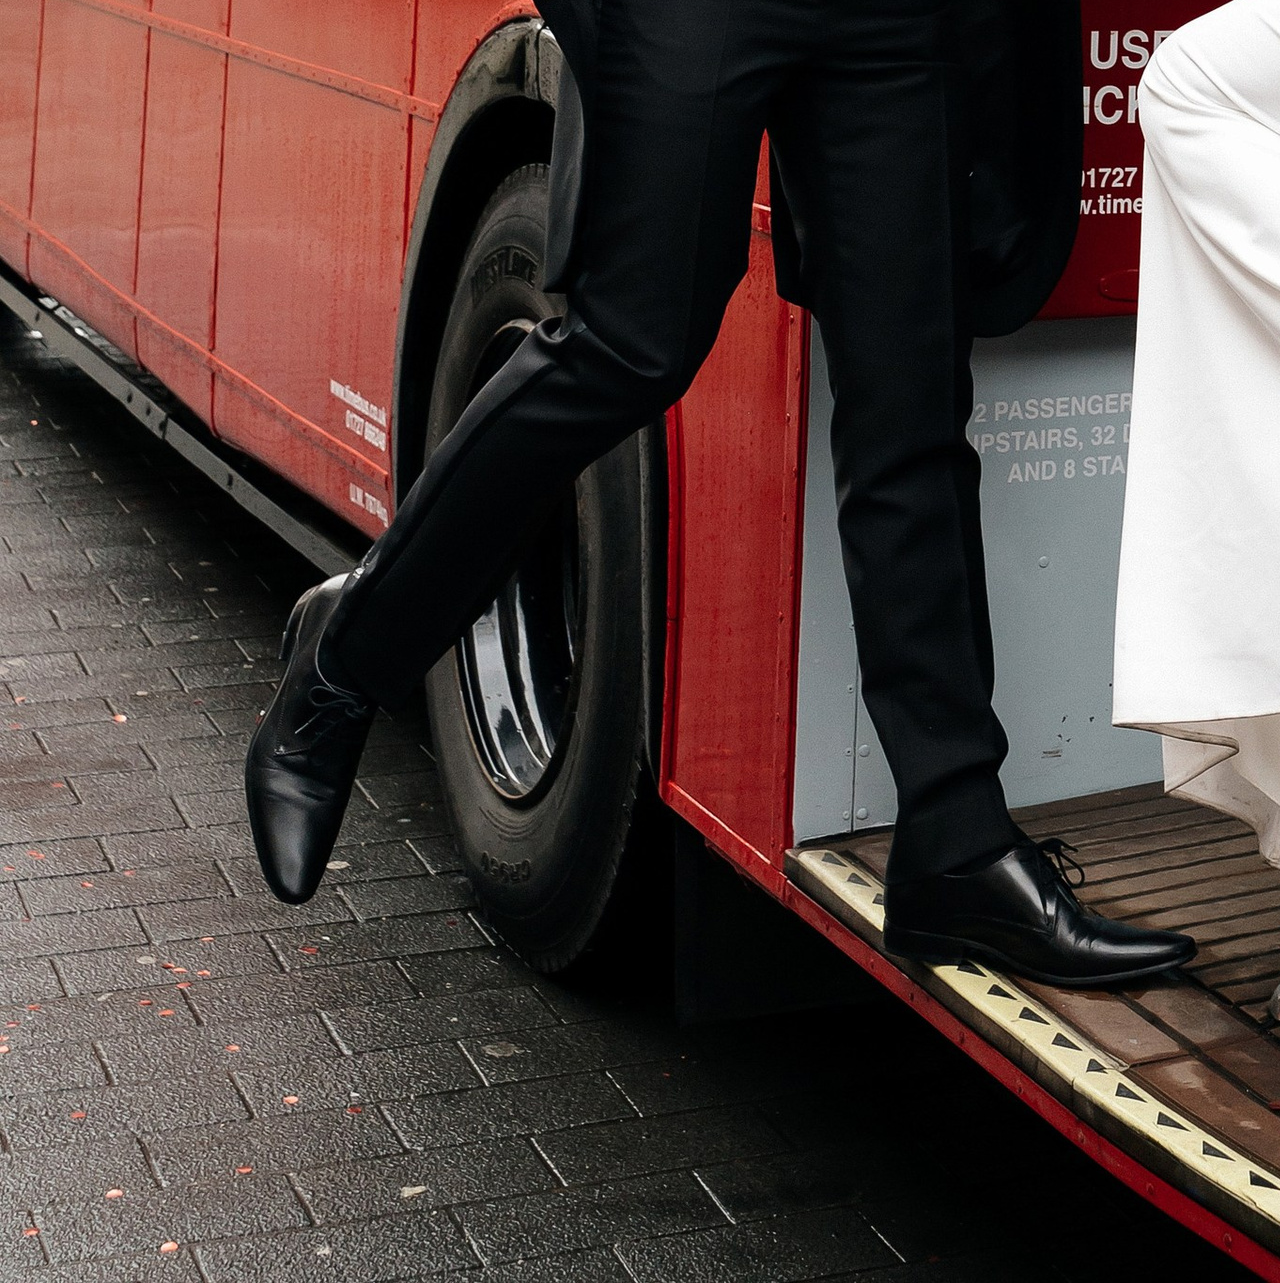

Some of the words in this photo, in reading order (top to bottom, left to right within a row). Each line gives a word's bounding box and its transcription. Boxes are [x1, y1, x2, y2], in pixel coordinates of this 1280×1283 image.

[1081, 167, 1138, 188] 1727
[1090, 424, 1116, 446] 32
[1007, 460, 1057, 483] AND
[1063, 459, 1076, 479] 8
[1083, 455, 1126, 477] STA
